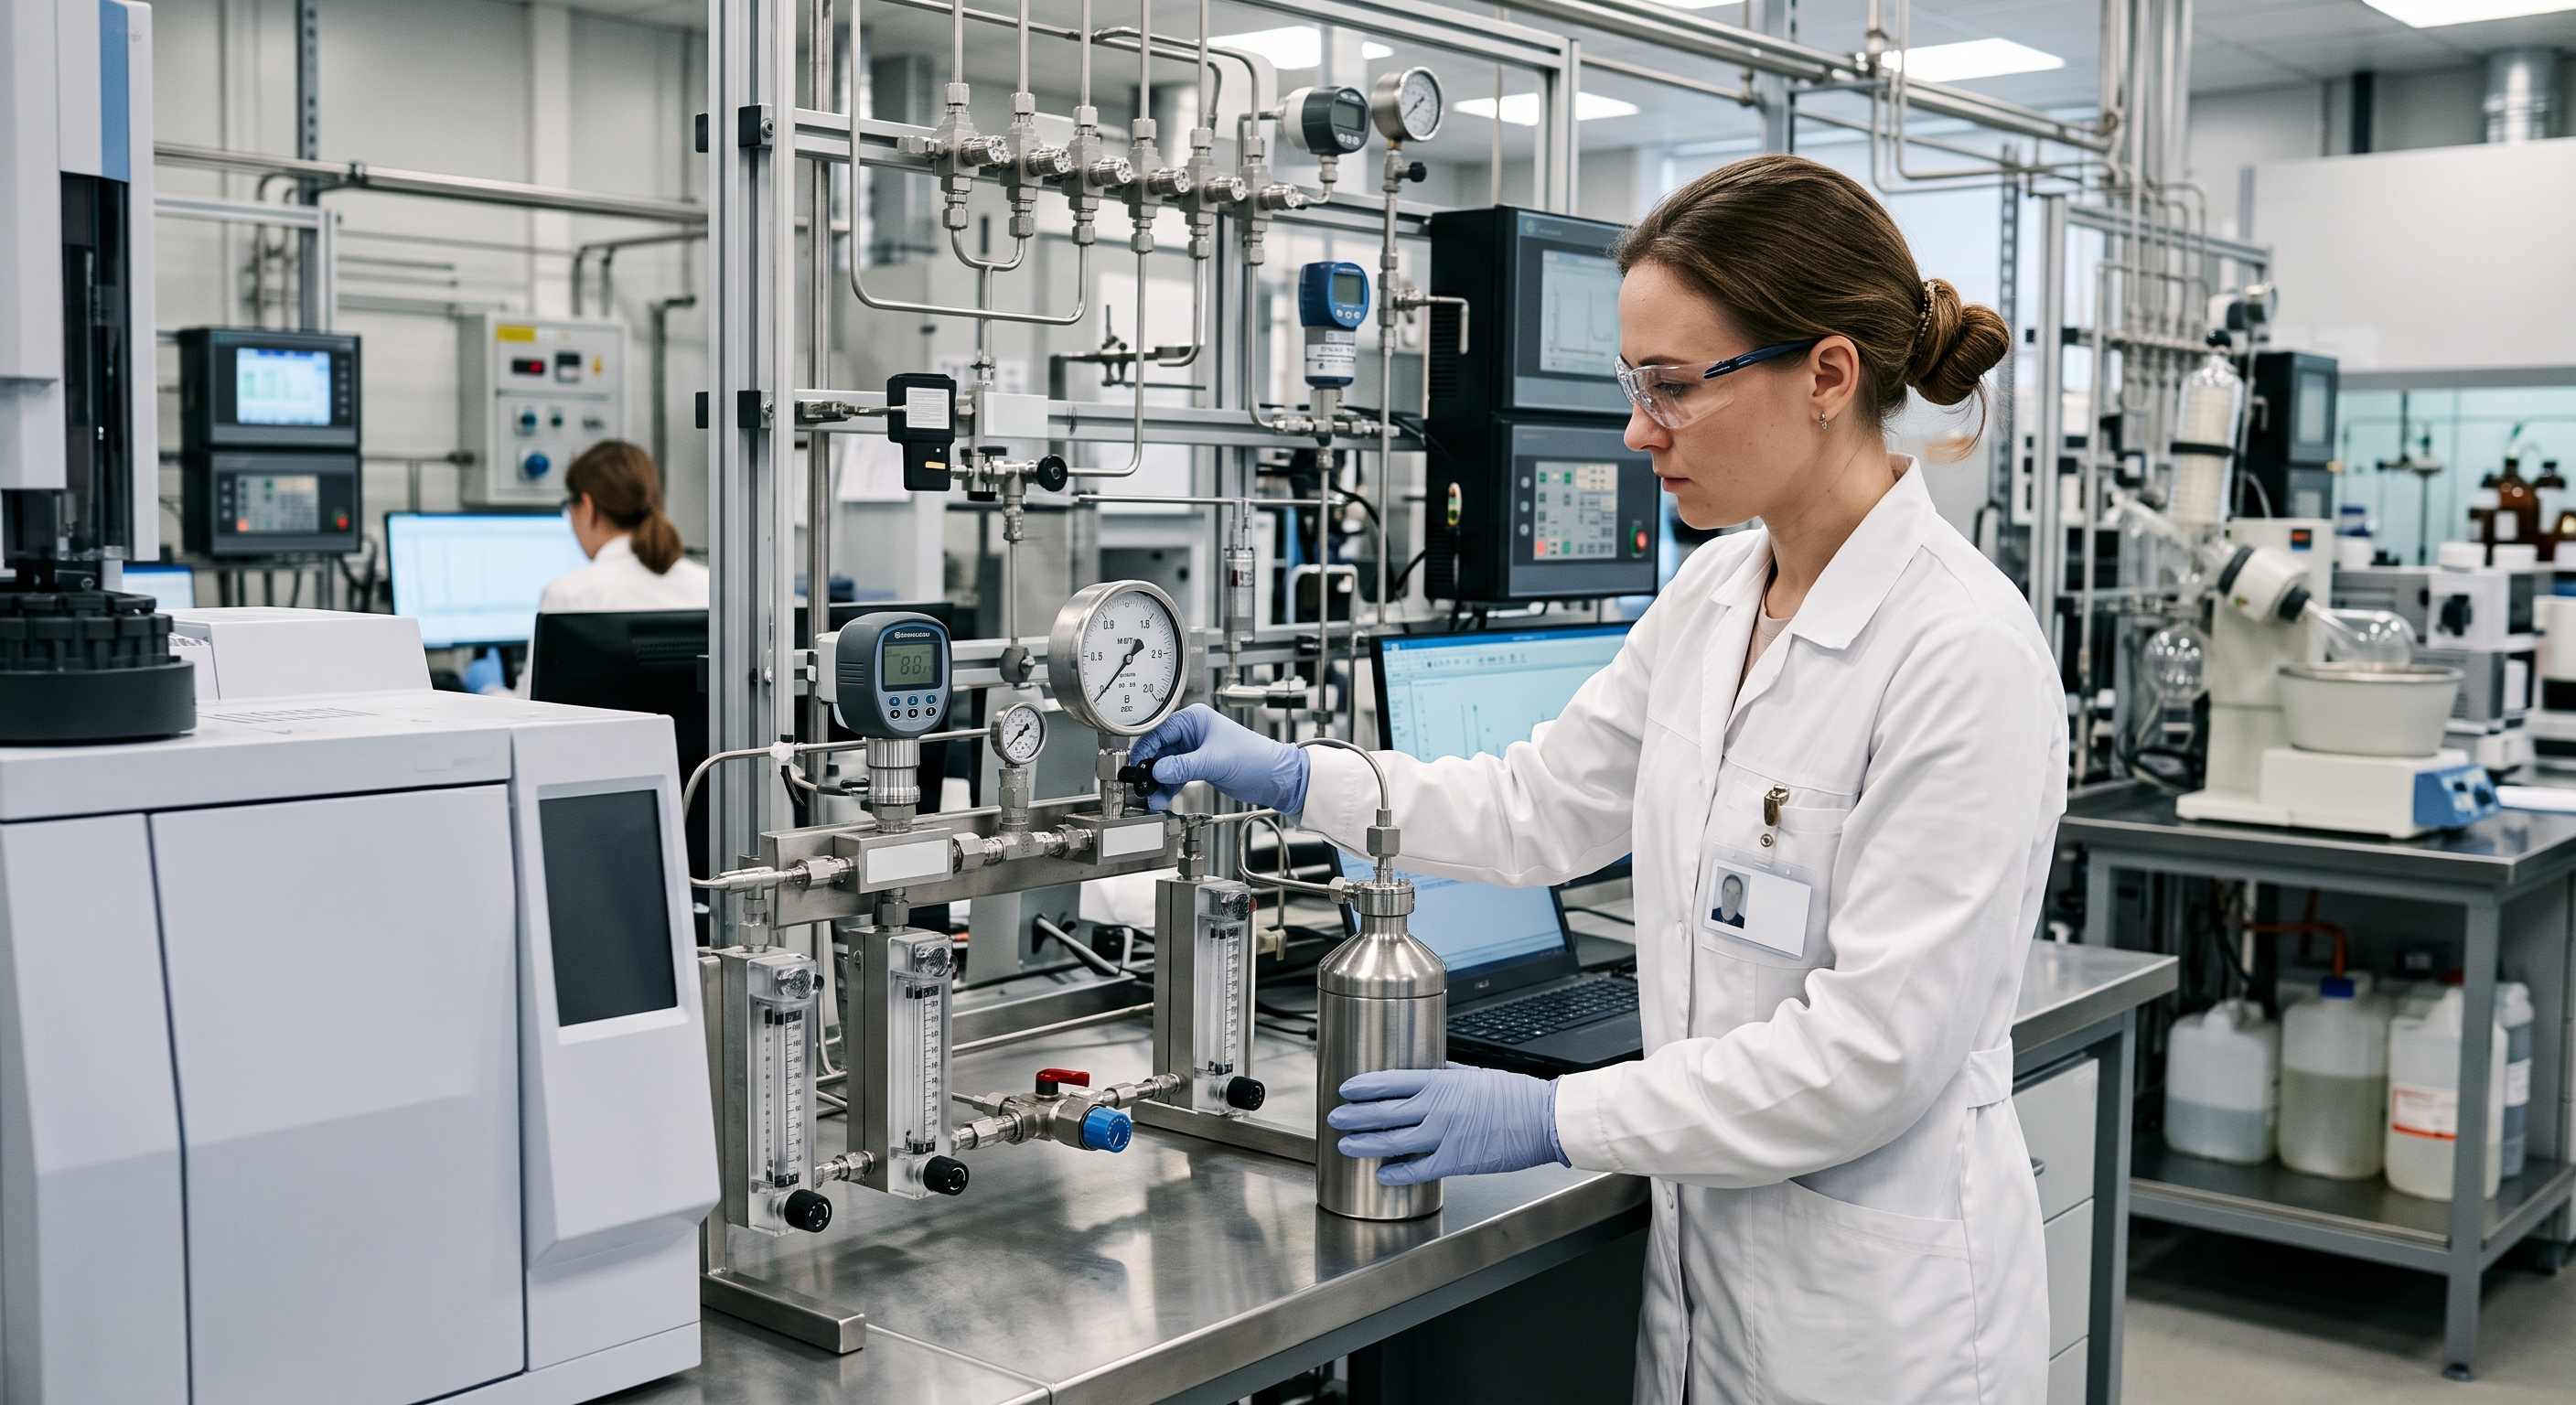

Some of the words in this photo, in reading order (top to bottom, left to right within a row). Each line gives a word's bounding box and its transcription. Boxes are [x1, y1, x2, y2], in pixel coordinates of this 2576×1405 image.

[1103, 620, 1114, 629] 0.9
[1090, 652, 1102, 660] 0.5
[1152, 649, 1163, 658] 2.9
